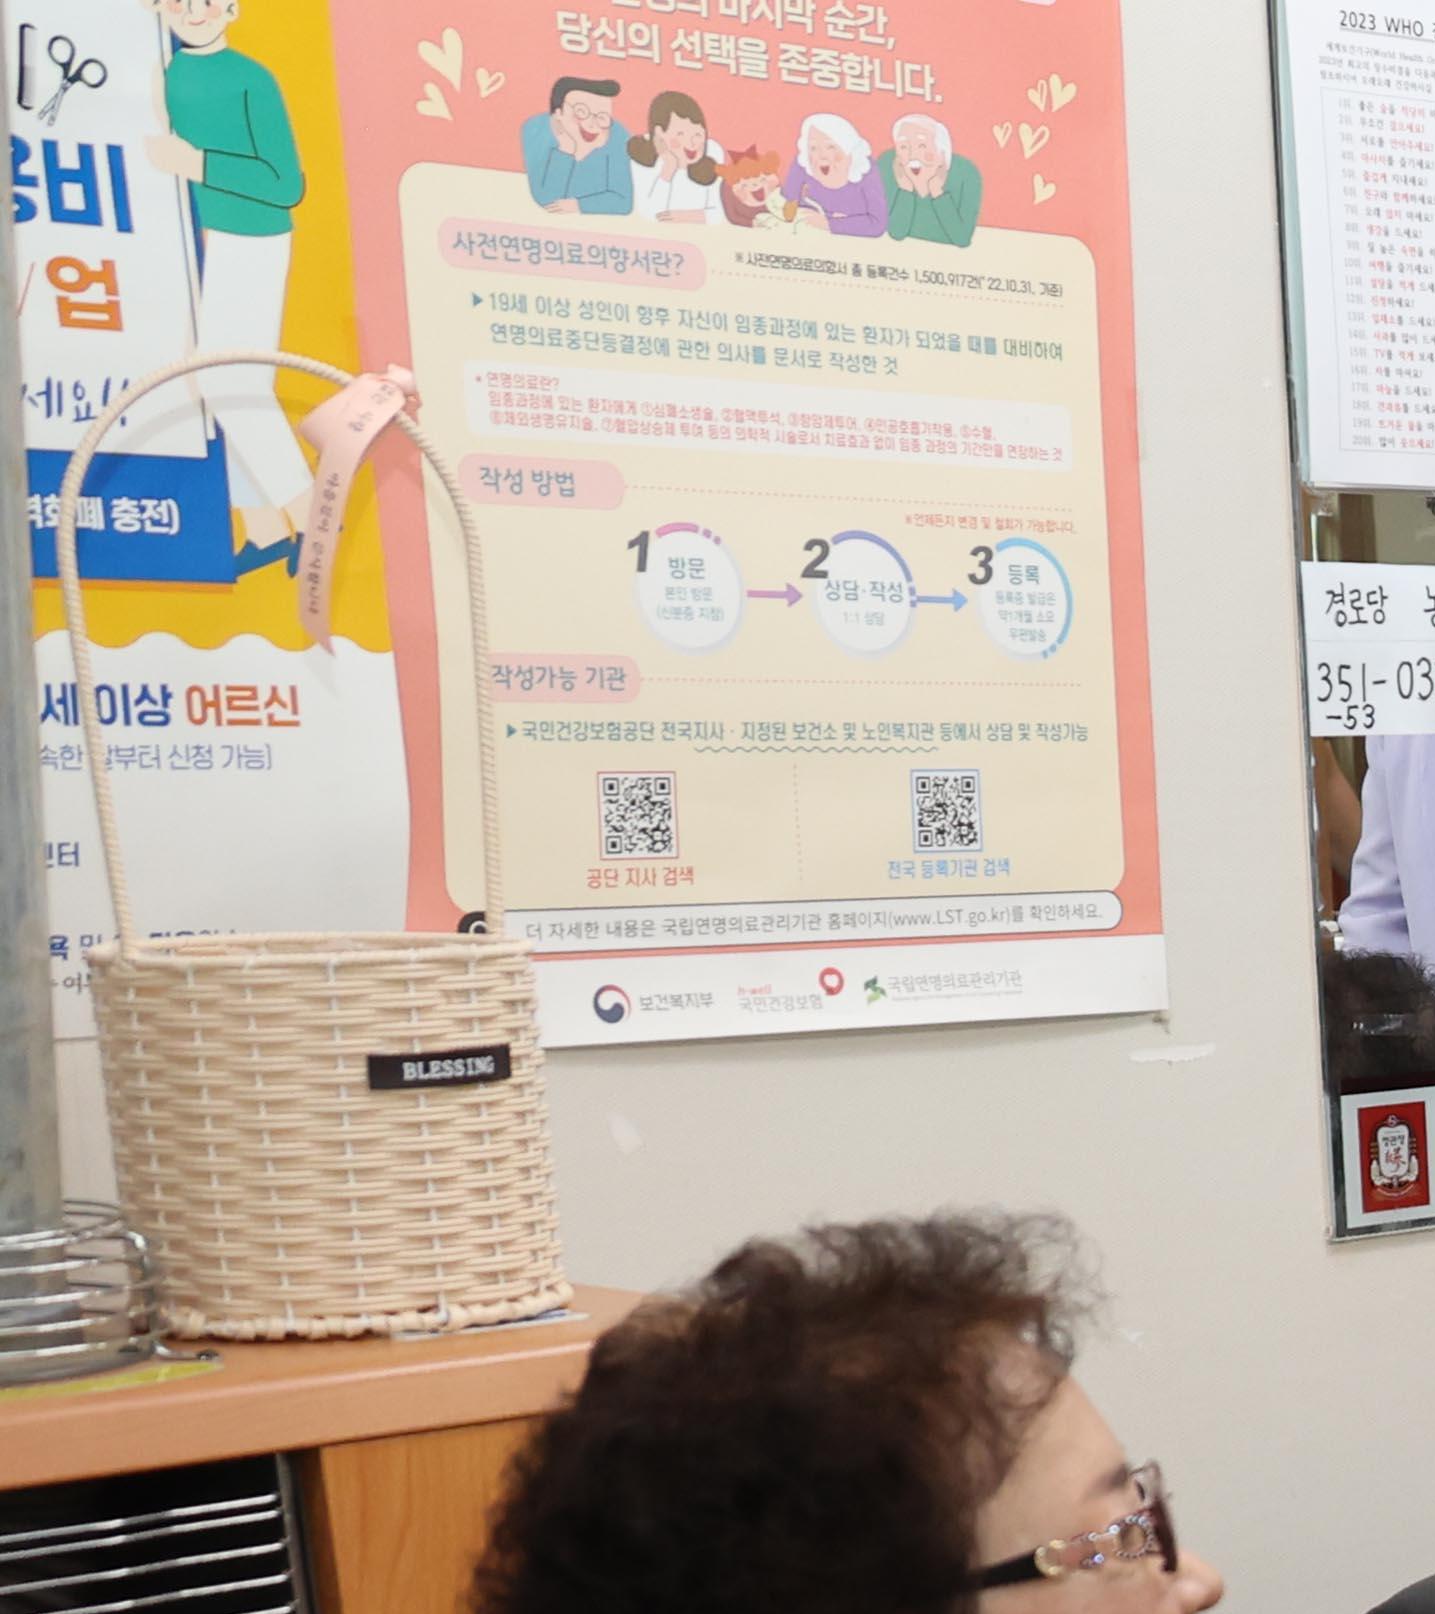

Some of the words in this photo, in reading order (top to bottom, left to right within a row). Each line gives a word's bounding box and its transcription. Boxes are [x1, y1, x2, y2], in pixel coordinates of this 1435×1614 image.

[719, 0, 815, 33] 마지막
[824, 2, 896, 50] 순간,
[1339, 10, 1377, 31] 2023
[1385, 16, 1424, 38] WHO
[557, 10, 661, 63] 당신의
[671, 28, 769, 79] 선택을
[778, 43, 943, 103] 존중합니다.
[453, 231, 685, 278] 사전연명의료의향서란?
[45, 256, 124, 332] 업
[489, 292, 528, 314] 19세
[535, 295, 570, 318] 이상
[579, 299, 631, 322] 성인이
[636, 304, 670, 326] 향후
[677, 308, 728, 332] 자신이
[735, 314, 818, 338] 임종과정에
[824, 321, 856, 343] 있는
[863, 325, 910, 347] 환자가
[915, 329, 961, 352] 되었을
[1004, 338, 1063, 362] 대비하여
[490, 323, 670, 357] 연명의료중단등결정에
[677, 339, 710, 360] 관한
[717, 342, 766, 365] 의사를
[774, 347, 822, 369] 문서로
[829, 352, 877, 374] 작성한
[884, 355, 898, 376] 것
[480, 467, 523, 496] 작성
[531, 470, 575, 498] 방법
[111, 496, 180, 536] 충전)
[627, 530, 650, 573] 1
[668, 557, 705, 580] 방문
[801, 538, 830, 579] 2
[967, 545, 993, 585] 3
[1008, 564, 1040, 585] 등록
[1326, 582, 1388, 627] 경로당
[492, 664, 577, 692] 작성가능
[585, 666, 626, 692] 기관
[40, 682, 80, 727] 세
[94, 683, 173, 727] 이상
[184, 684, 301, 727] 어르신
[1326, 704, 1375, 729] -53
[522, 721, 655, 741] 국민건강보험공단
[660, 721, 724, 741] 전국지사
[741, 721, 786, 741] 지정된
[792, 722, 837, 741] 보건소
[843, 722, 857, 741] 및
[863, 722, 934, 742] 노인복지관
[940, 722, 981, 742] 등에서
[987, 722, 1013, 742] 상담
[1018, 722, 1031, 742] 및
[1037, 723, 1088, 742] 작성가능
[104, 743, 161, 771] 부터
[168, 744, 214, 771] 신청
[587, 868, 619, 889] 공단
[625, 867, 657, 888] 지사
[663, 866, 695, 886] 검색
[888, 860, 915, 880] 전국
[921, 859, 978, 879] 등록기관
[984, 858, 1010, 877] 검색
[526, 923, 542, 941] 더
[548, 920, 599, 940] 자세한
[606, 919, 656, 938] 내용은
[662, 914, 822, 937] 국립연명의료관리기관
[1029, 903, 1103, 922] 확인하세요.
[640, 991, 714, 1012] 보건복지부
[402, 1055, 496, 1081] BLESSING
